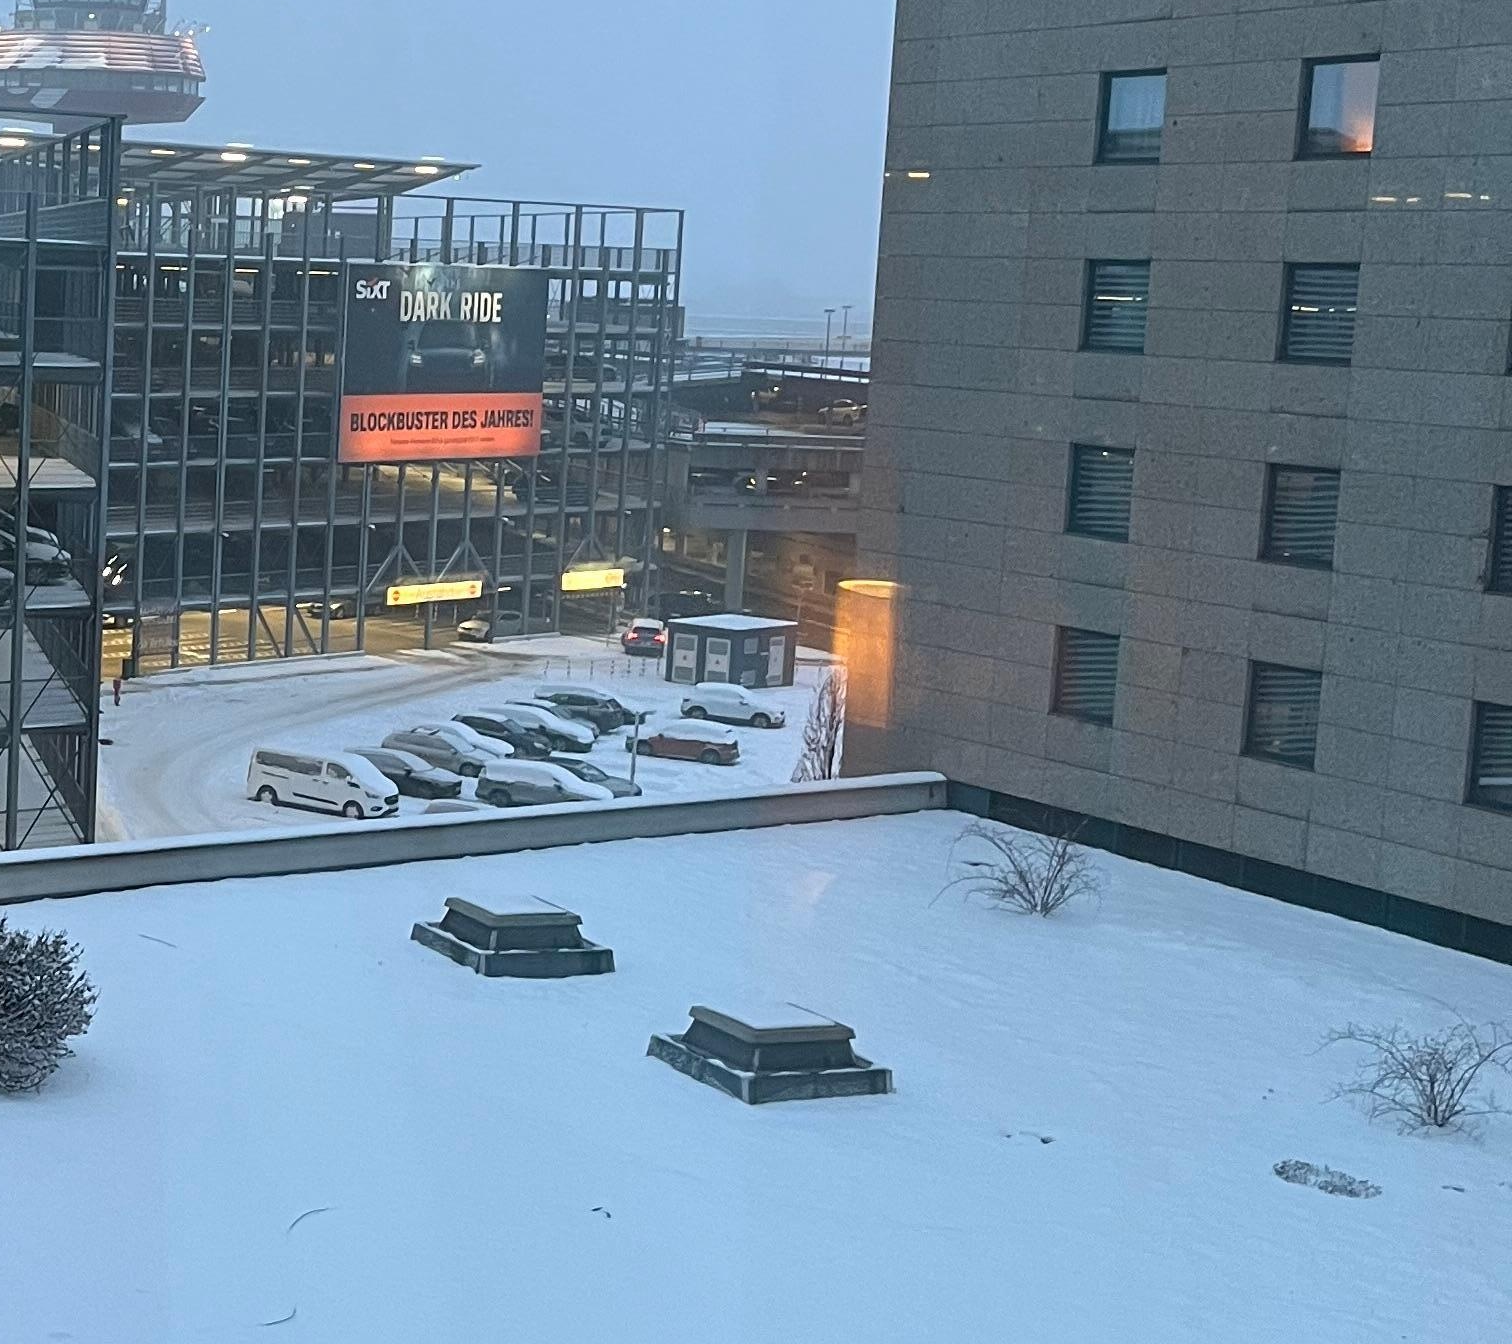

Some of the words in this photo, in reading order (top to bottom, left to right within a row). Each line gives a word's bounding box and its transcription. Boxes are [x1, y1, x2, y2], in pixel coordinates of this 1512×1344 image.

[400, 291, 452, 321] DARK
[461, 292, 502, 322] RIDE
[351, 412, 448, 431] BLOCKBUSTER
[452, 410, 476, 429] DES
[482, 409, 533, 428] JAHRES!
